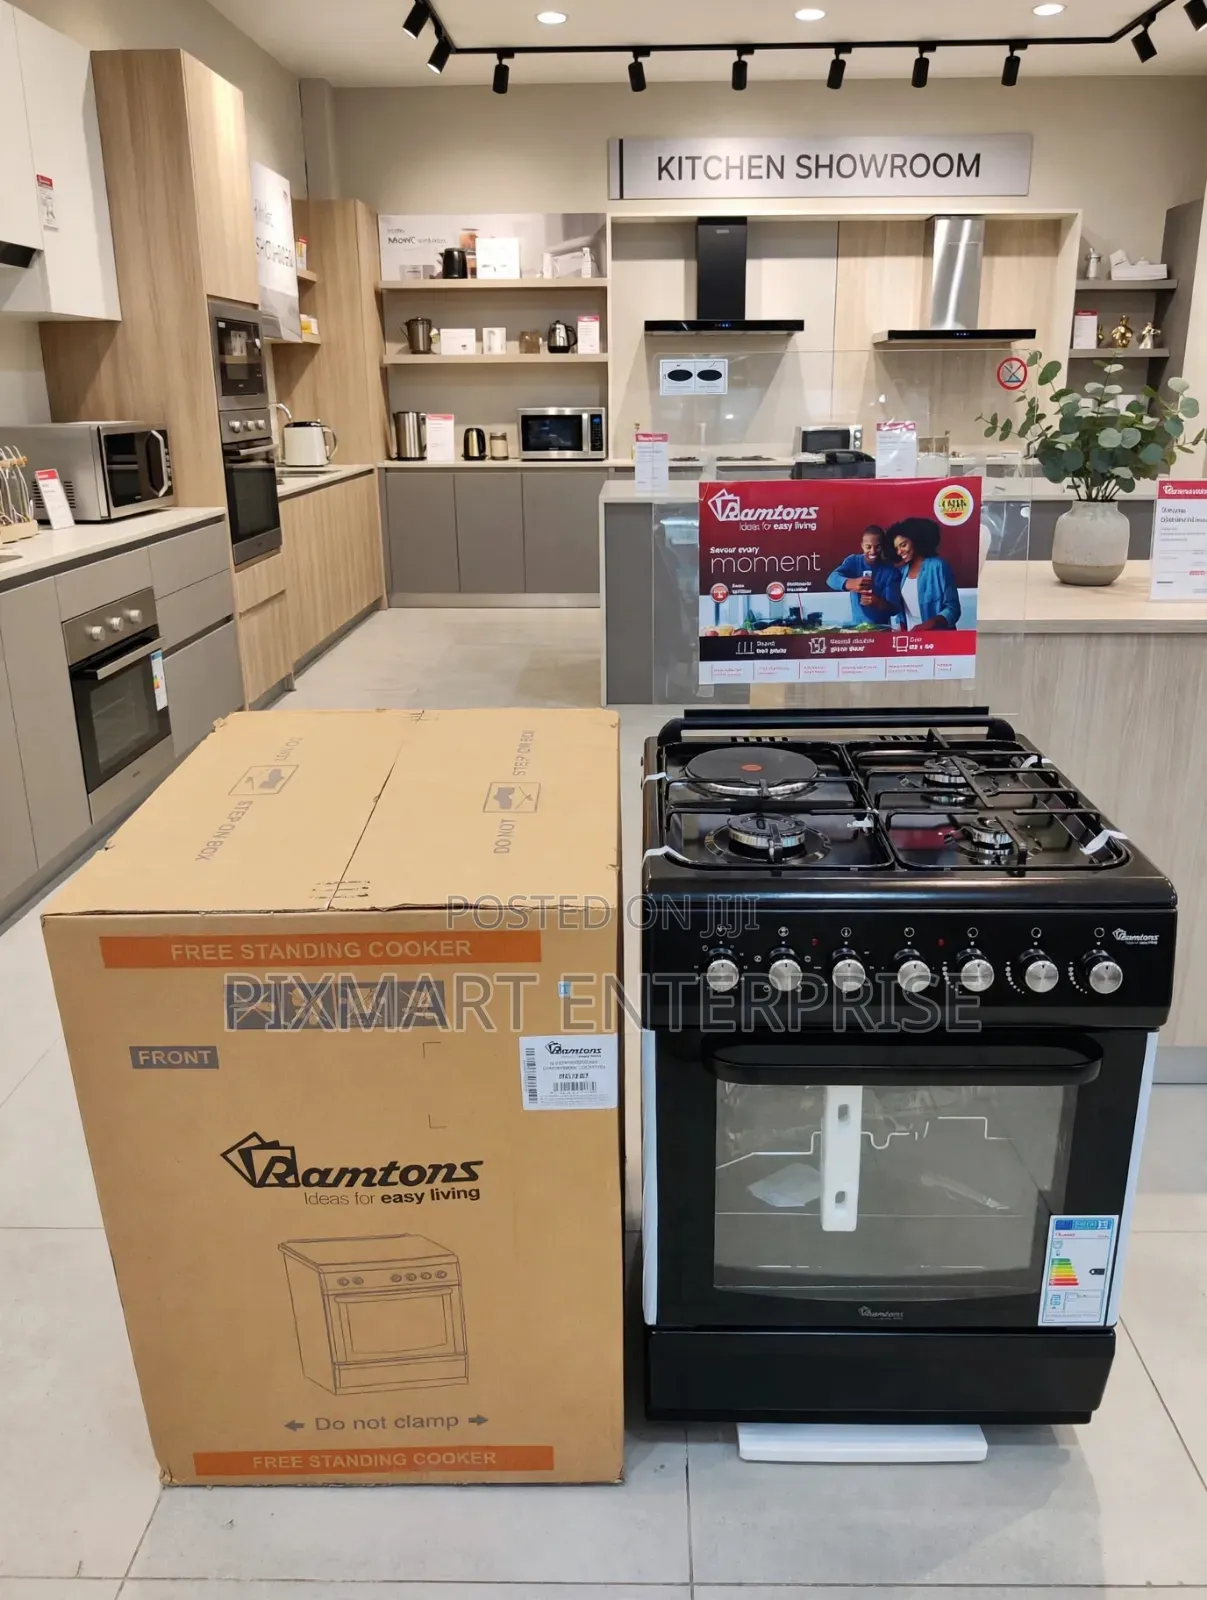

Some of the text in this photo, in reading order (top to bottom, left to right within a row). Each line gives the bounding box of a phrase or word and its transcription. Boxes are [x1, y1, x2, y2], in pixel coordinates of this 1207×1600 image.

[657, 152, 981, 181] KITCHEN SHOWROOM
[716, 497, 819, 521] Ramtons
[773, 521, 793, 531] easy
[795, 521, 816, 531] living
[711, 551, 821, 574] moment
[195, 800, 253, 861] STEP ON BOX
[493, 818, 517, 854] DO NOT
[171, 940, 472, 961] FREE STANDING COOKER
[138, 1050, 212, 1065] FRONT
[549, 1043, 602, 1055] Ramtons
[238, 1145, 484, 1188] Ramtons
[304, 1187, 481, 1205] Ideas for easy living
[315, 1414, 459, 1432] Do not clamp
[253, 1451, 497, 1469] FREE STANDING COOKER
